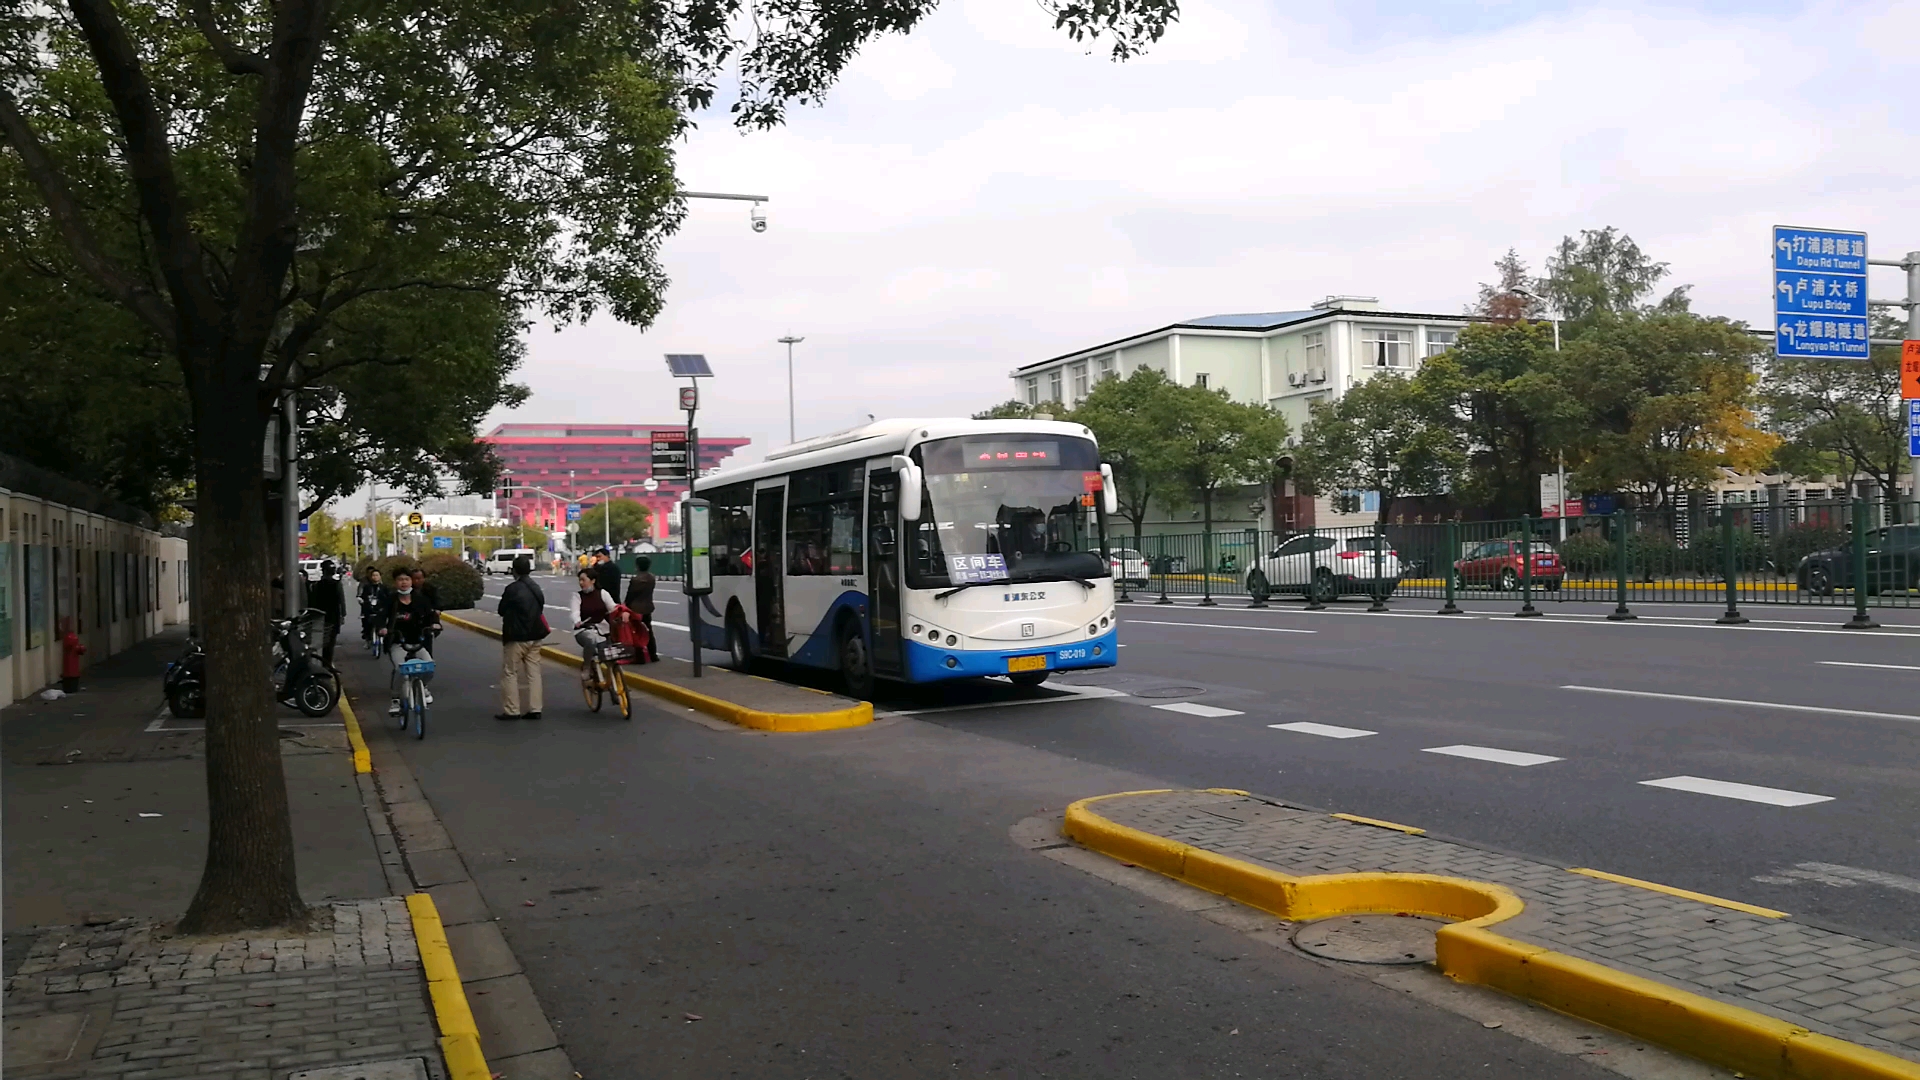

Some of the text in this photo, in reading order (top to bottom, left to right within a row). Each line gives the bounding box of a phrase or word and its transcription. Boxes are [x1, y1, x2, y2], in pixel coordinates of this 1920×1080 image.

[1792, 235, 1865, 257] 打浦路隧道
[1797, 256, 1861, 270] Dapu Rd Tunnel
[1795, 277, 1859, 299] 卢浦大桥
[1802, 299, 1852, 312] Lupu Bridge
[1795, 320, 1867, 341] 龙耀路隧道
[1795, 340, 1867, 353] Longyao Rd Tunnel
[953, 555, 1004, 570] 区间车
